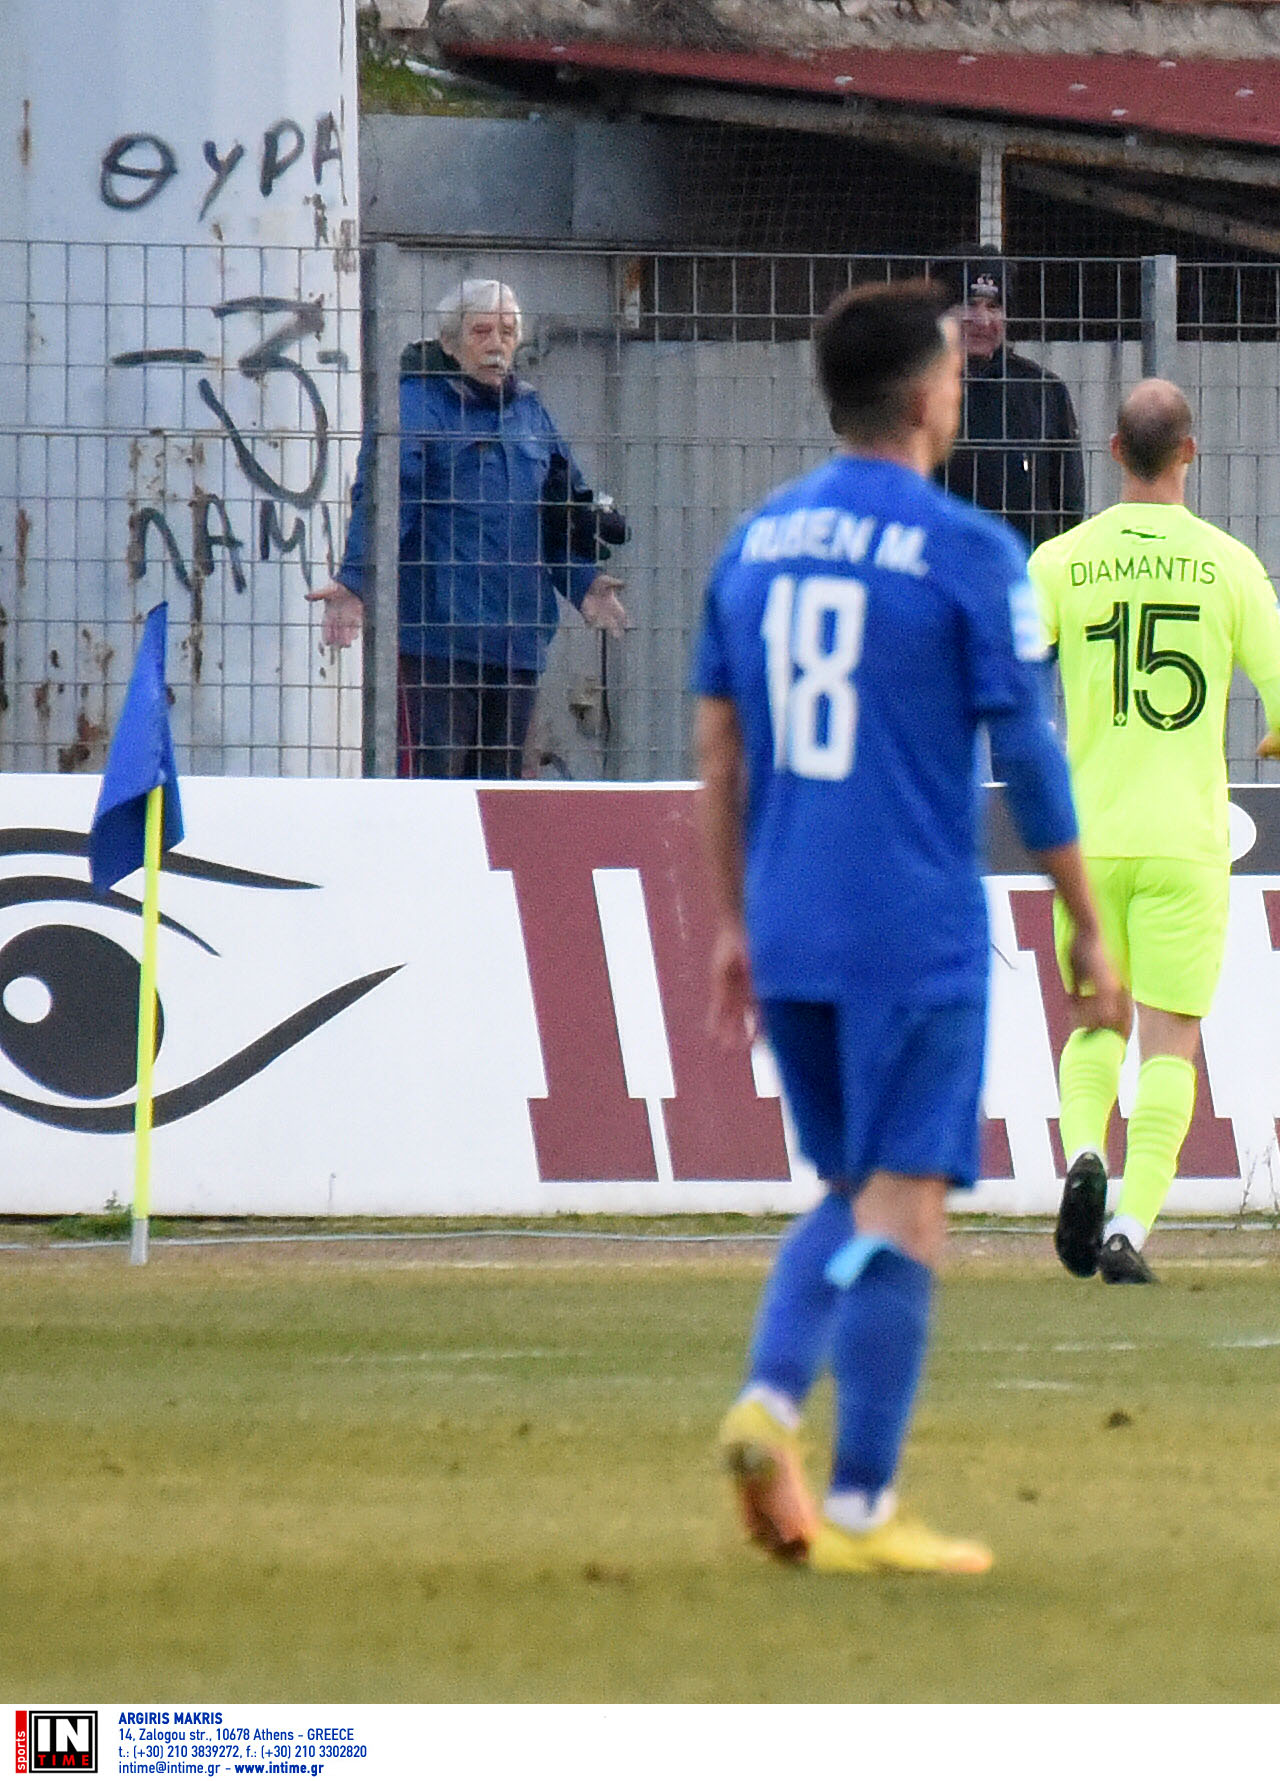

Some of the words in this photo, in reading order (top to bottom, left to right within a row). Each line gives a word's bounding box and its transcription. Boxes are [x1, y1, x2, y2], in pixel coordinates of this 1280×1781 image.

[1070, 557, 1216, 587] DIAMANTIS
[762, 575, 868, 782] 18
[1086, 601, 1207, 732] 15
